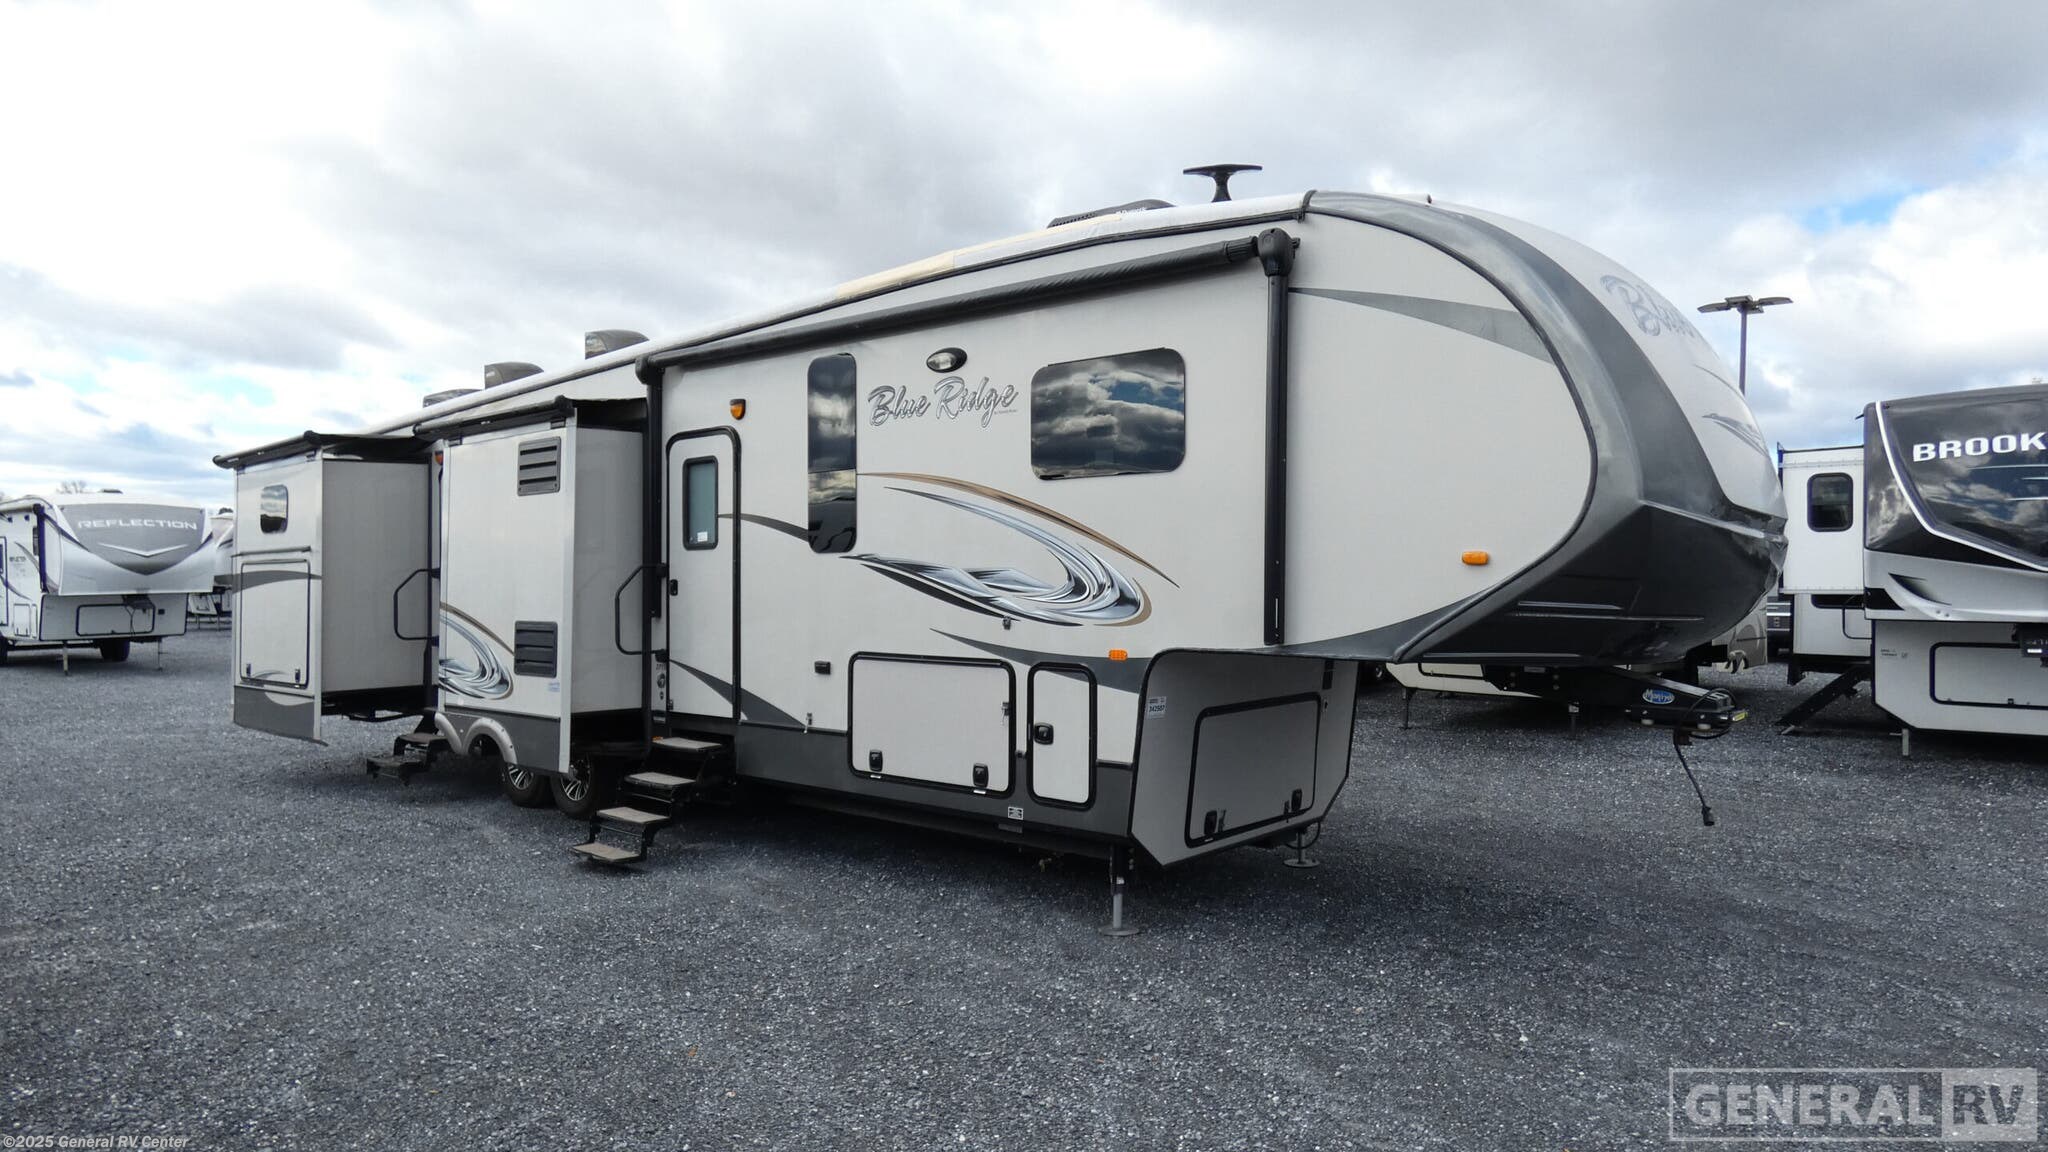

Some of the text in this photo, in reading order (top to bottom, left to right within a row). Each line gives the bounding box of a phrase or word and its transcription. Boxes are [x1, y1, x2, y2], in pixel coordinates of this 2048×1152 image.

[868, 376, 1019, 428] Blue Ridge
[1913, 432, 2047, 462] BROOK
[78, 518, 198, 530] REFLECTION
